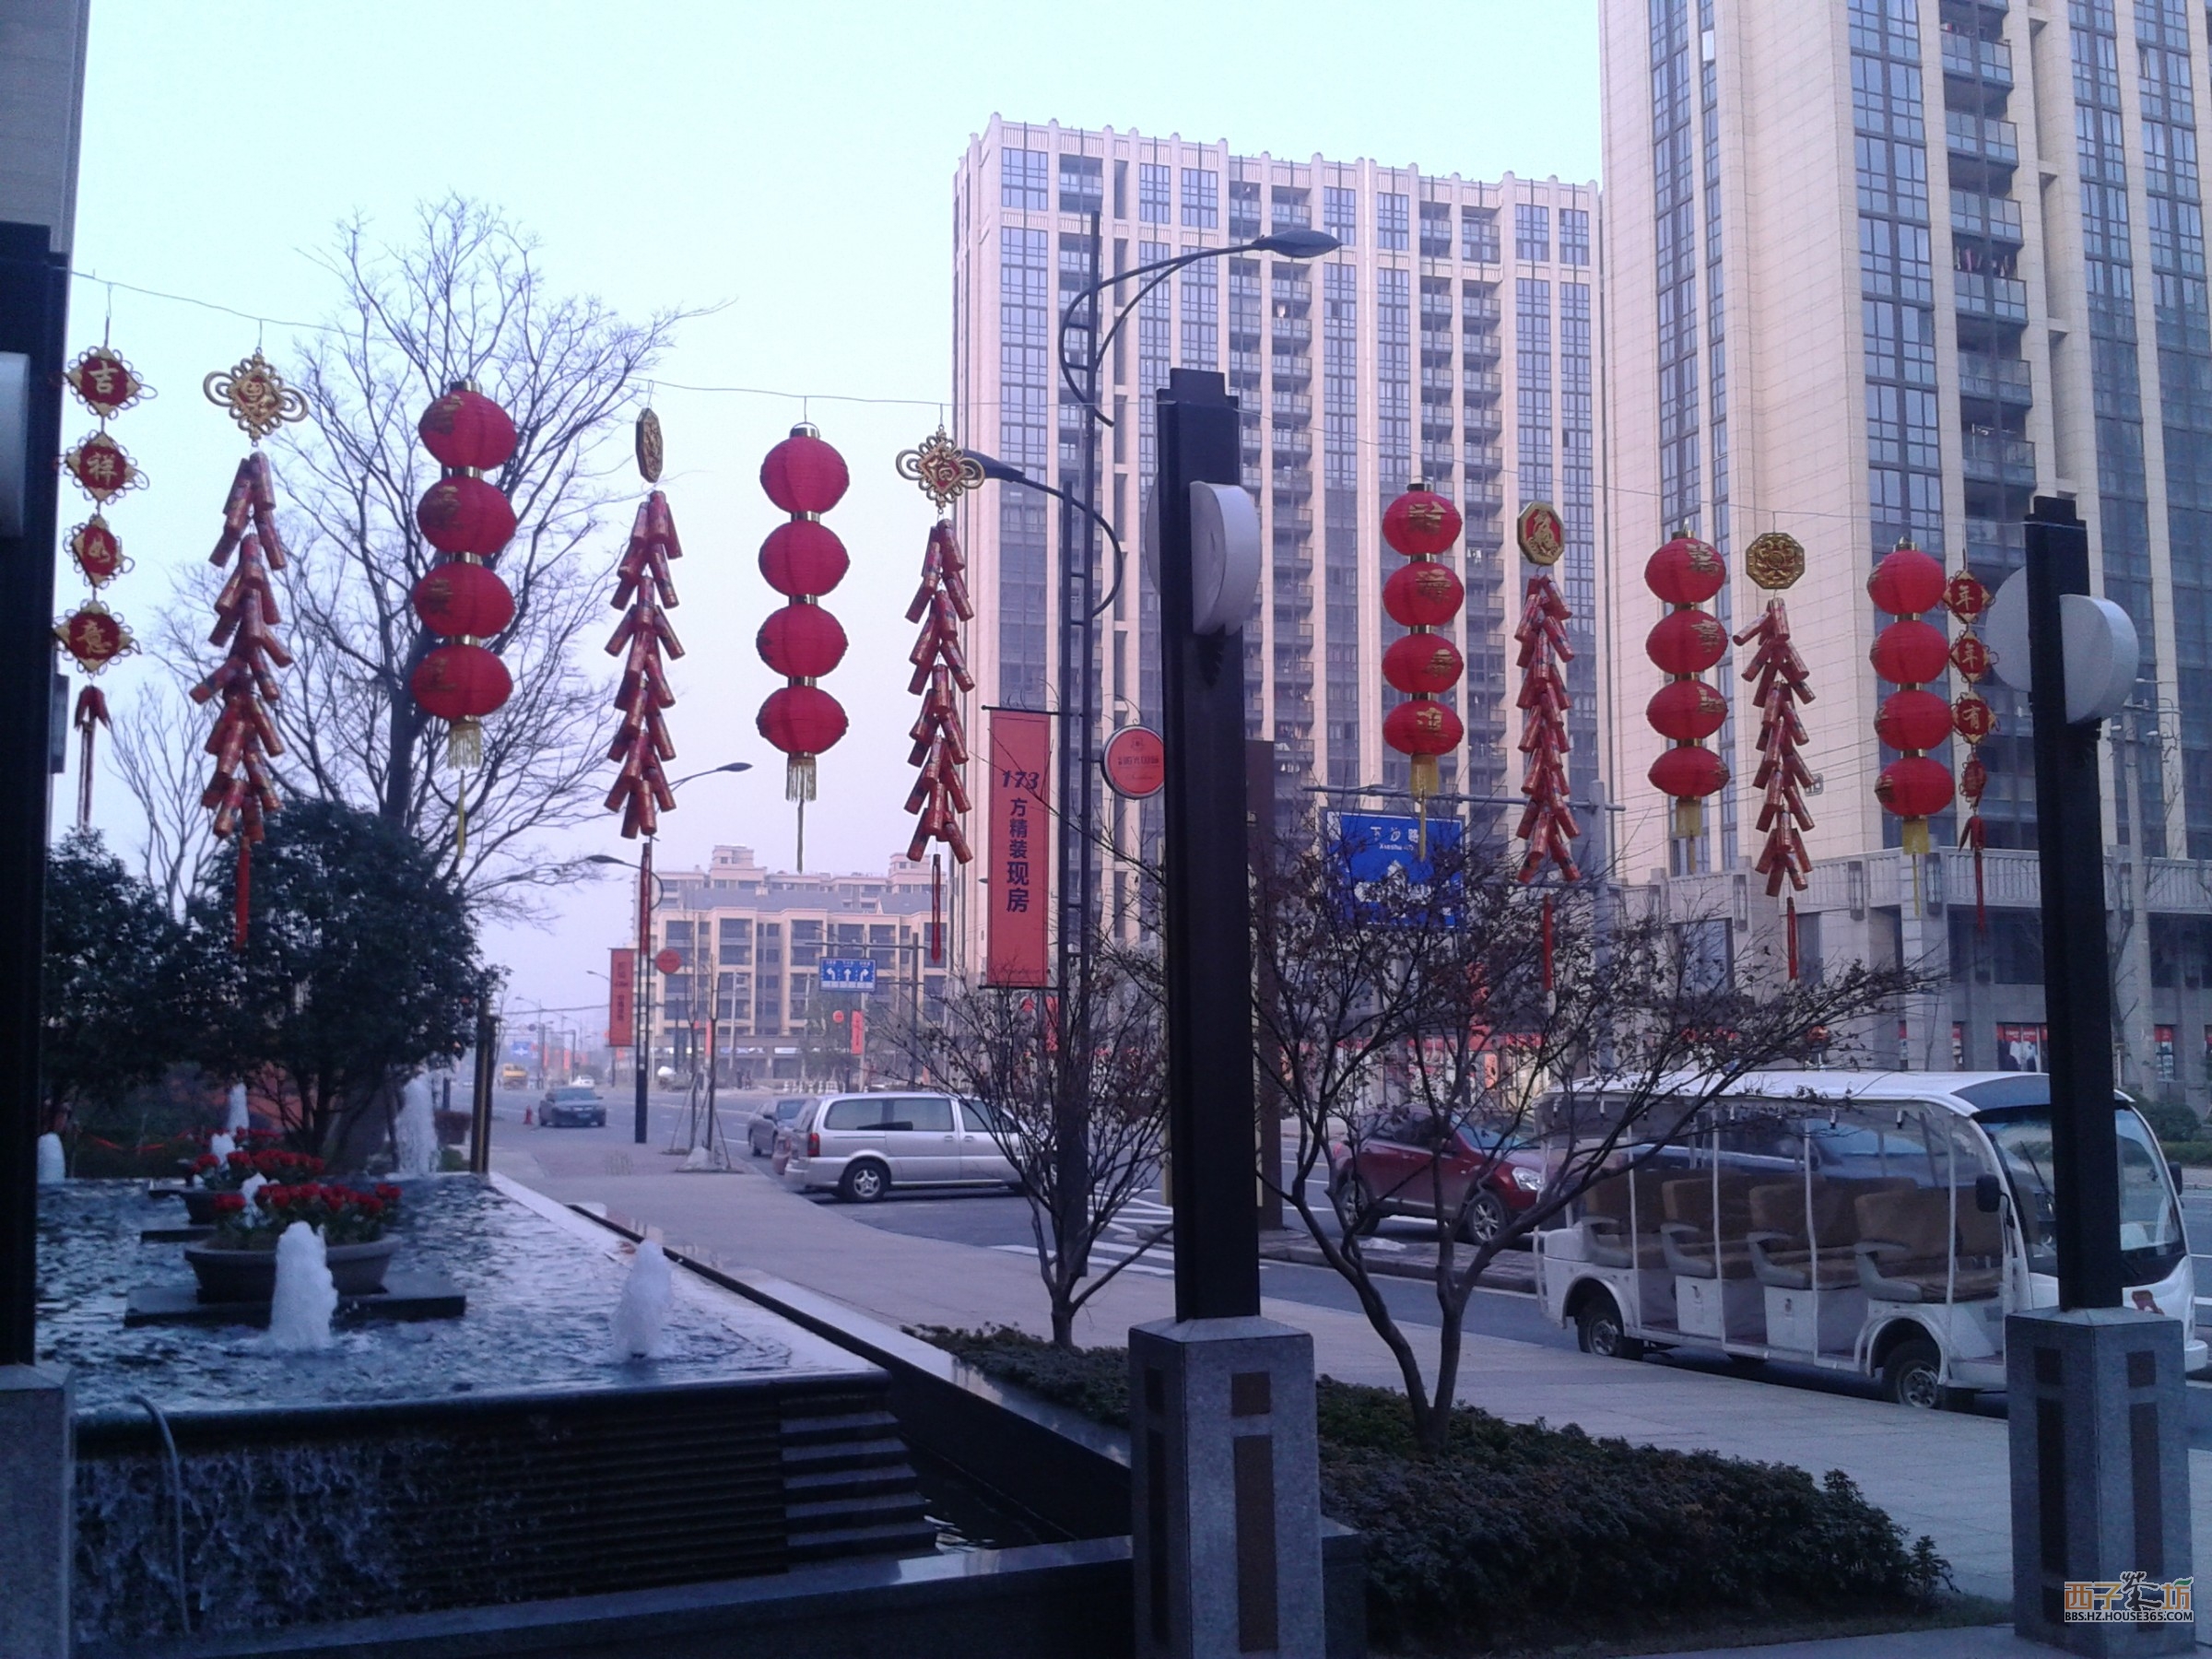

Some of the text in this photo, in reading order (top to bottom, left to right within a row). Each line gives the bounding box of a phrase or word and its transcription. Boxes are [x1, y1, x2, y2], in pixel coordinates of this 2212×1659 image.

[75, 360, 118, 655] 吉祥如意
[1955, 584, 1983, 785] 年年有
[1001, 770, 1040, 790] 173
[1006, 797, 1030, 913] 方精装现房
